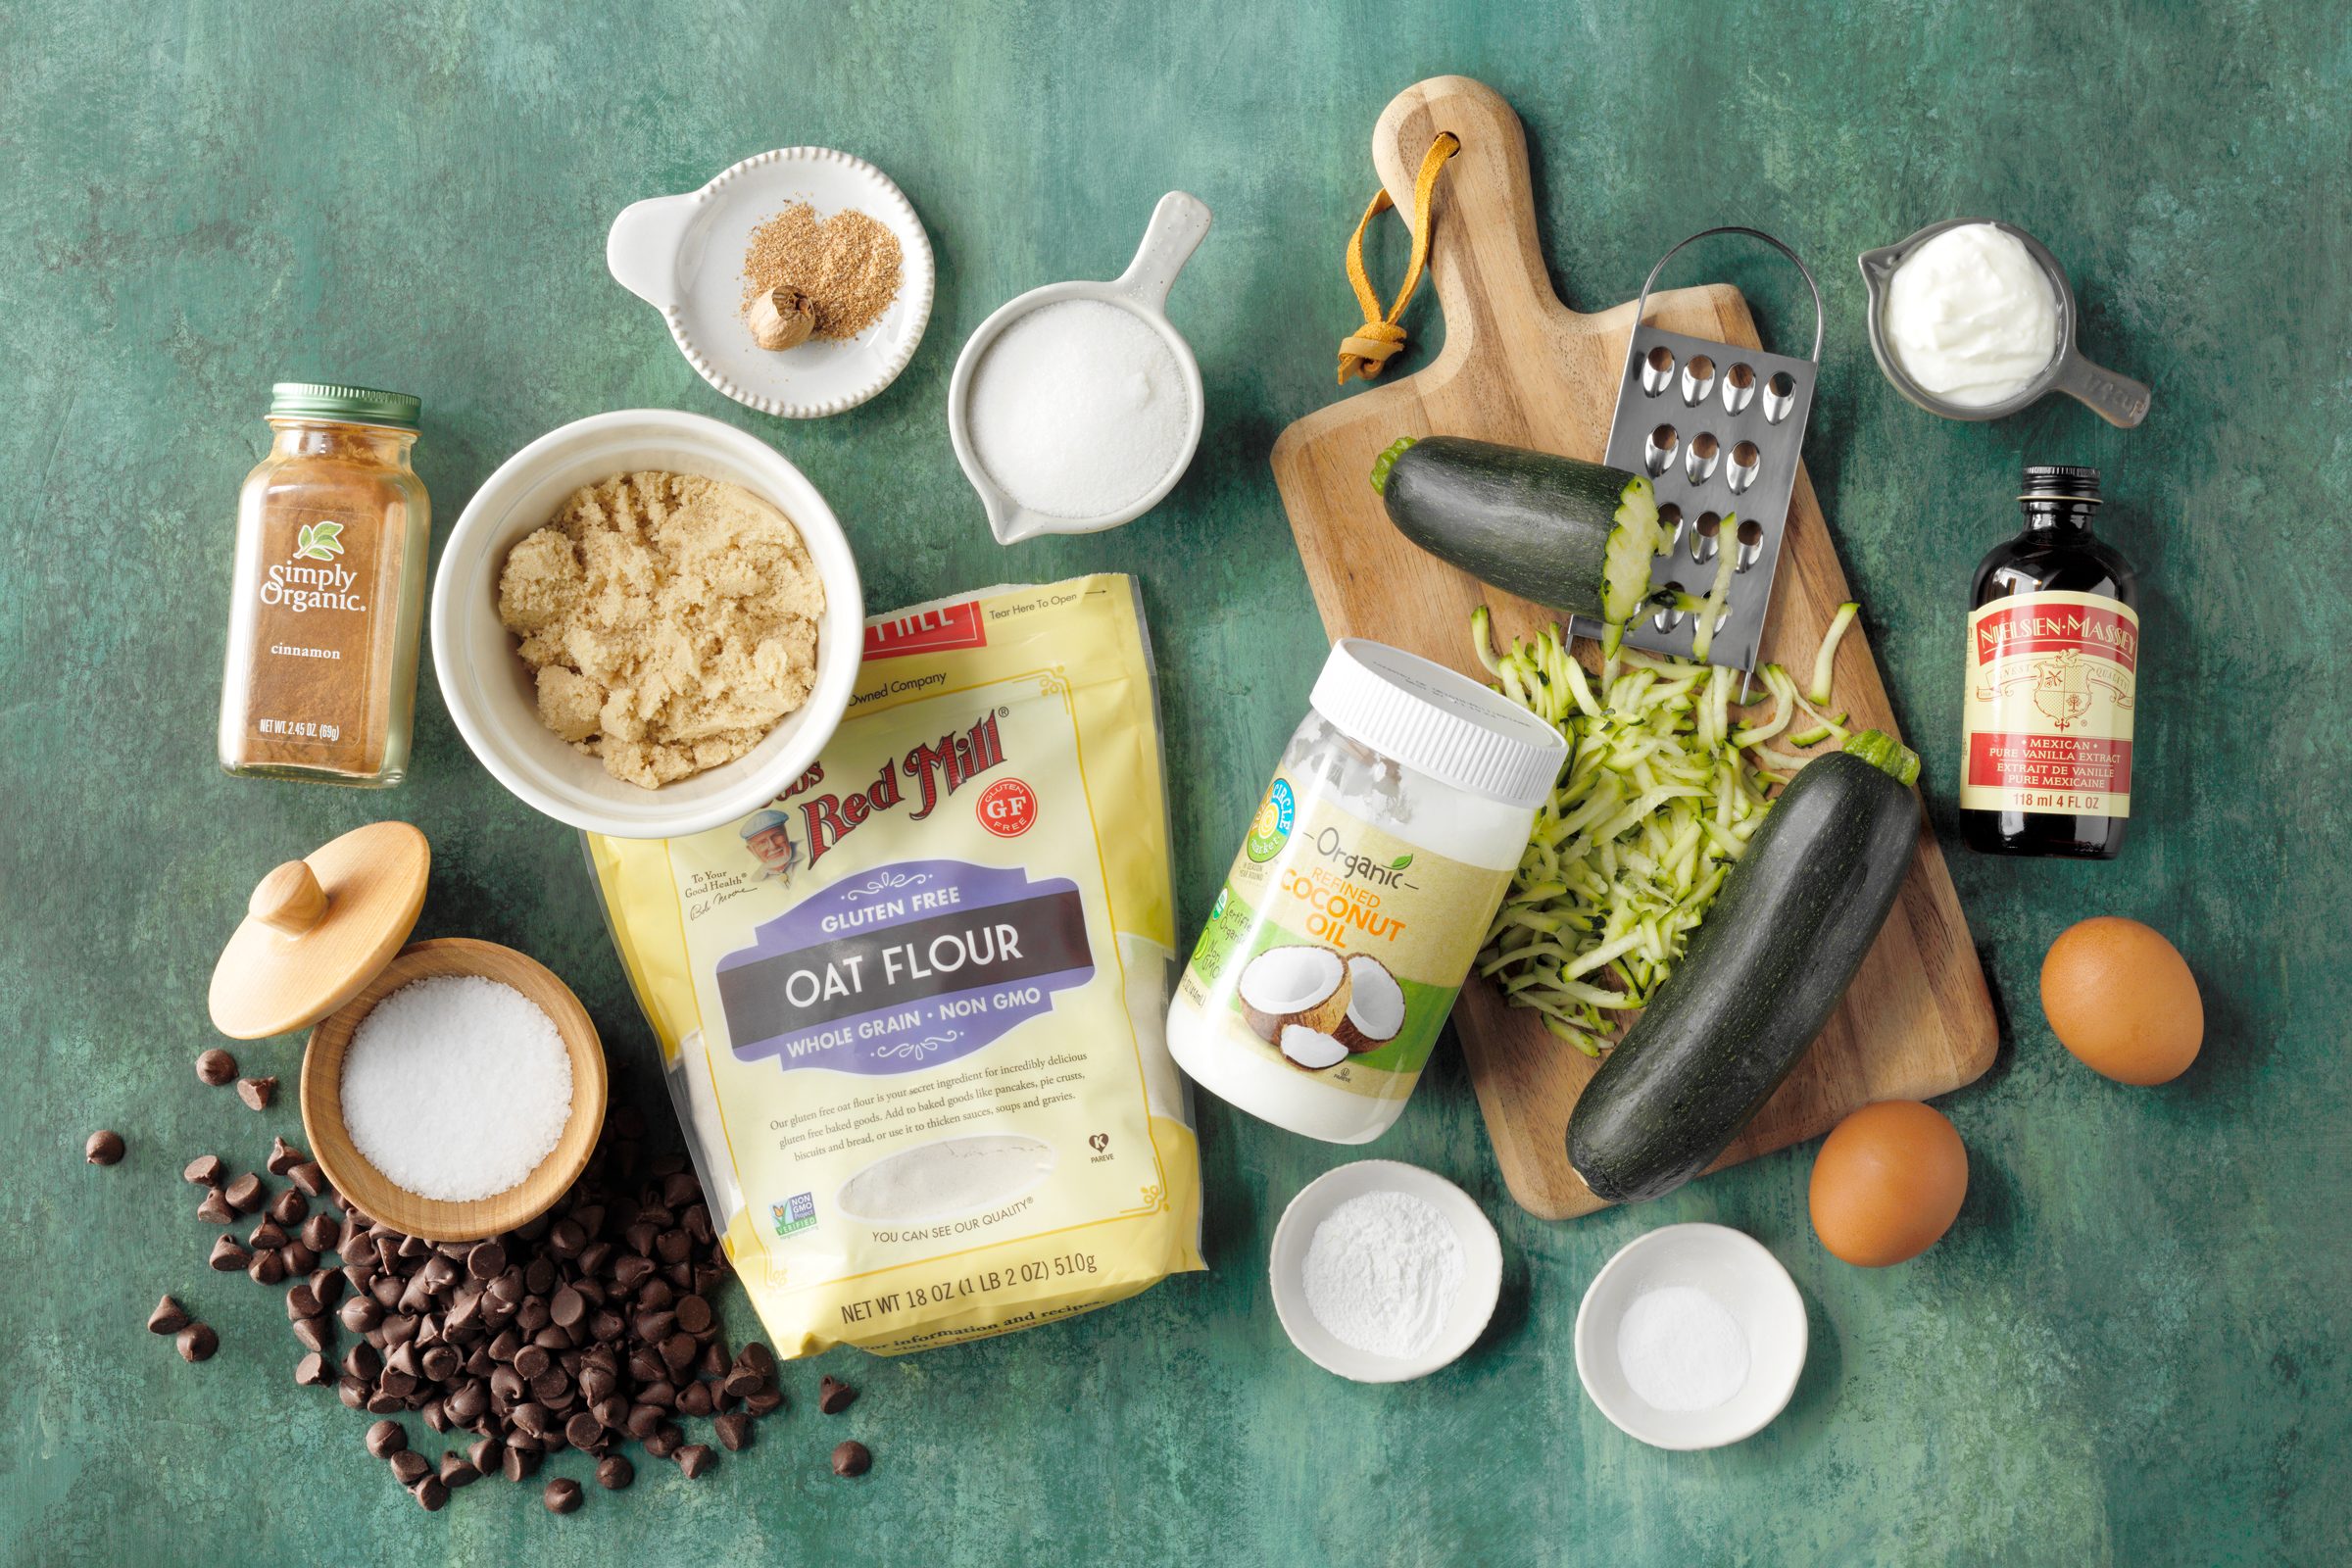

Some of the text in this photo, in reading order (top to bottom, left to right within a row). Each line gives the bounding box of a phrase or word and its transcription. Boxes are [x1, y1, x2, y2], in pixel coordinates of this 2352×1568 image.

[269, 560, 358, 593] Simply
[989, 594, 1077, 620] Tear Here To Open
[270, 642, 340, 660] cinnamon
[891, 672, 947, 693] Company
[260, 718, 273, 733] NET
[288, 721, 305, 736] 2.45
[319, 723, 340, 742] (69g)
[1989, 748, 2121, 763] PURE VANILLA EXTRACT
[2030, 738, 2090, 750] MEXICAN
[1996, 762, 2115, 778] EXTRAIT DE VANILLE
[2008, 774, 2105, 788] PURE MEXICAINE
[985, 783, 1025, 803] GLUTEN
[2014, 793, 2099, 809] 118 ml 4 FL OZ
[798, 757, 906, 870] Red
[987, 796, 1027, 819] GF
[1272, 783, 1293, 830] CIRCLE
[993, 816, 1027, 832] FREE
[1250, 837, 1279, 855] market
[1316, 826, 1404, 890] Organic
[691, 870, 727, 884] To Your
[1312, 866, 1381, 908] REFINED
[684, 883, 709, 899] Good
[820, 886, 961, 933] GLUTEN FREE
[1226, 900, 1252, 931] Certifie
[1280, 867, 1406, 942] COCONUT
[1305, 911, 1348, 949] OIL
[1208, 939, 1221, 961] Non
[785, 923, 1024, 1008] OAT FLOUR
[1201, 954, 1221, 979] GMO
[786, 987, 1041, 1058] WHOLE GRAIN NON GMO
[769, 1053, 1088, 1131] Our gluten free oat flour is your secret ingredient for incredibly delicious
[779, 1135, 806, 1150] gluten
[808, 1128, 824, 1140] free
[825, 1119, 852, 1134] baked
[854, 1112, 883, 1129] goods.
[885, 1106, 906, 1120] Add
[906, 1103, 916, 1114] to
[917, 1097, 946, 1111] baked
[948, 1092, 974, 1107] goods
[976, 1087, 993, 1099] like
[995, 1079, 1038, 1097] pancakes,
[1040, 1076, 1054, 1089] pie
[794, 1091, 1076, 1162] biscuits and bread, or use it to thicken sauces, soups and gravies.
[1090, 1152, 1114, 1164] PAREVE
[791, 1194, 810, 1206] NON
[793, 1201, 812, 1213] GMO
[778, 1216, 815, 1235] VERIFIED
[872, 1231, 899, 1243] YOU
[902, 1229, 929, 1243] CAN
[932, 1225, 952, 1239] SEE
[955, 1218, 980, 1234] OUR
[841, 1251, 1098, 1325] NET WT 18 OZ (1 LB 2 OZ) 510g
[893, 1323, 999, 1347] information
[1003, 1311, 1036, 1326] and
